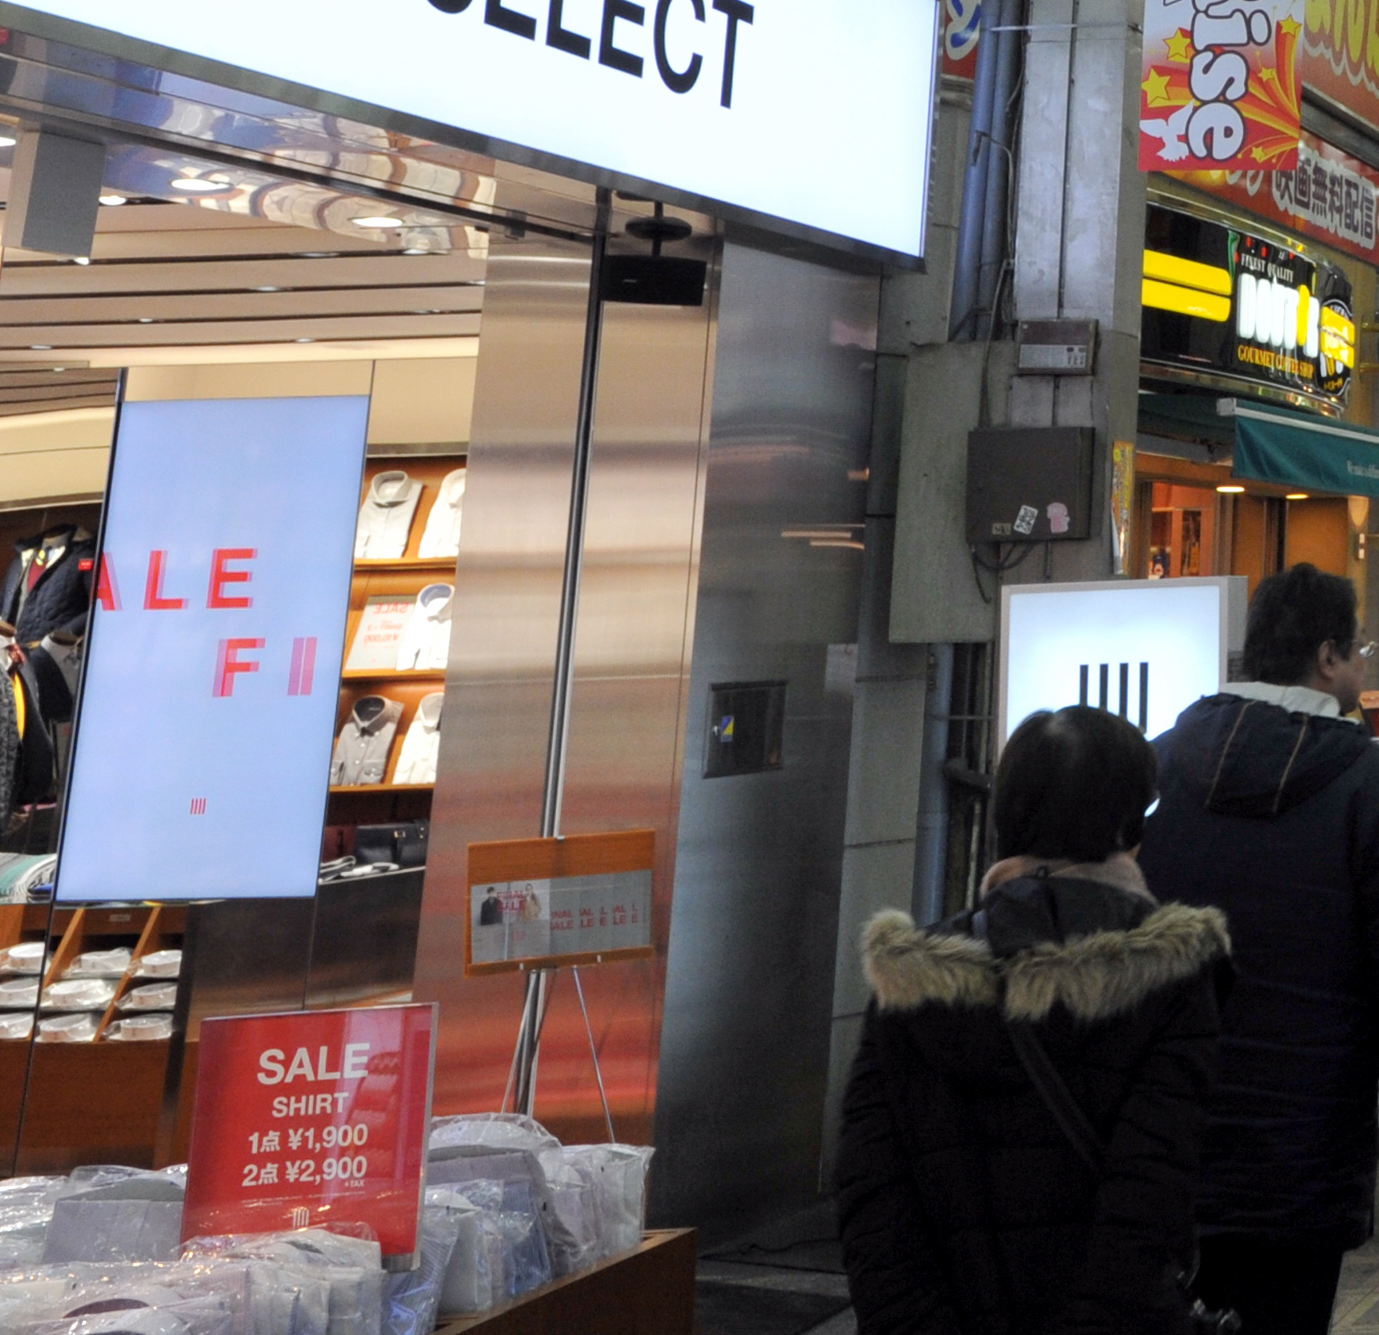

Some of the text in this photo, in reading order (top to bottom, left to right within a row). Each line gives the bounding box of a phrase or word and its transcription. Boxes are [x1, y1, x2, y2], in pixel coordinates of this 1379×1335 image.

[257, 1042, 371, 1086] SALE
[271, 1091, 349, 1118] SHIRT
[248, 1123, 369, 1154] 1点 ¥1,900
[241, 1155, 368, 1187] 2点 ¥2,900
